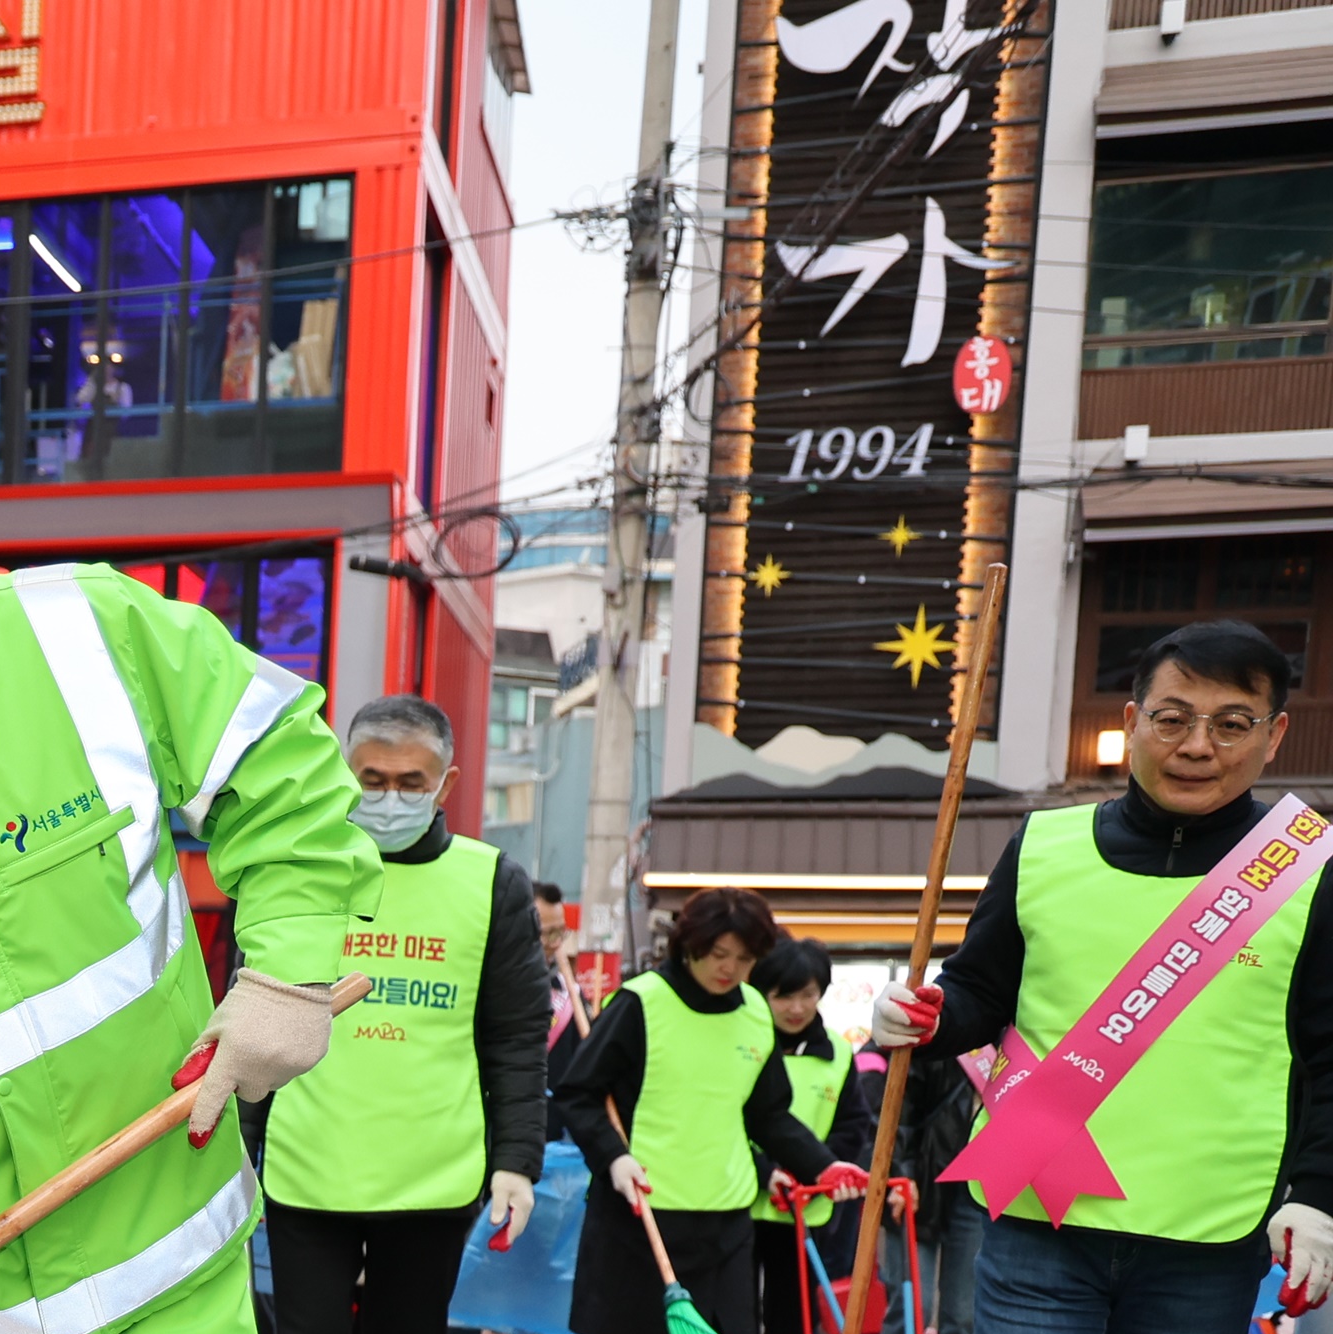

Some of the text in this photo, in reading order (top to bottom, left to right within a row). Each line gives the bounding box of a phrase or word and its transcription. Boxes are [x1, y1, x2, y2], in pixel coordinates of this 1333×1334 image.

[960, 336, 1003, 411] 홍대
[779, 423, 933, 483] 1994
[32, 785, 104, 832] 서울특별시
[1238, 838, 1299, 891] 마포
[1190, 885, 1252, 943] 함께
[404, 935, 447, 962] 마포
[1097, 939, 1202, 1045] 만들어요
